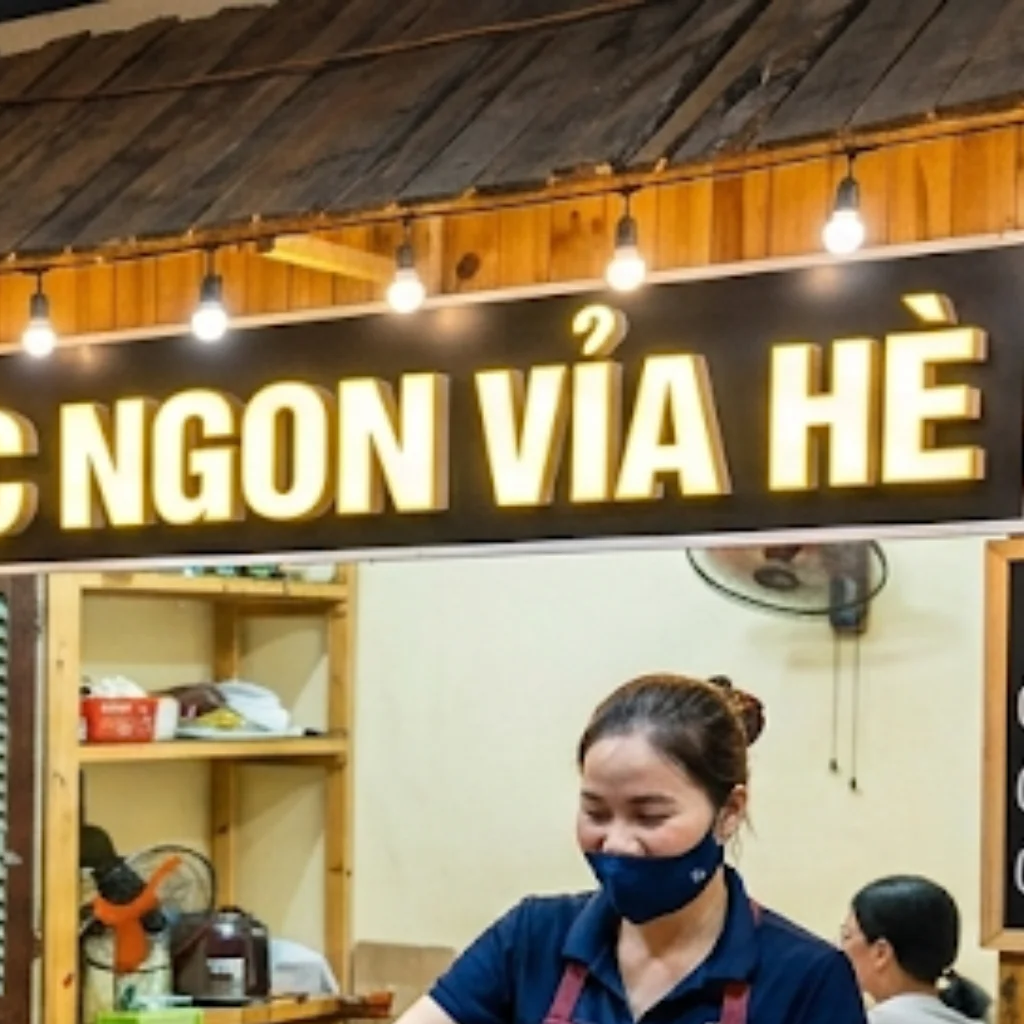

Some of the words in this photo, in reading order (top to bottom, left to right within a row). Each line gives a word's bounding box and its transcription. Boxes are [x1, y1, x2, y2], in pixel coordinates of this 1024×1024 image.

[58, 371, 450, 531] NGON
[476, 302, 733, 508] VỈA
[768, 292, 989, 493] HÈ
